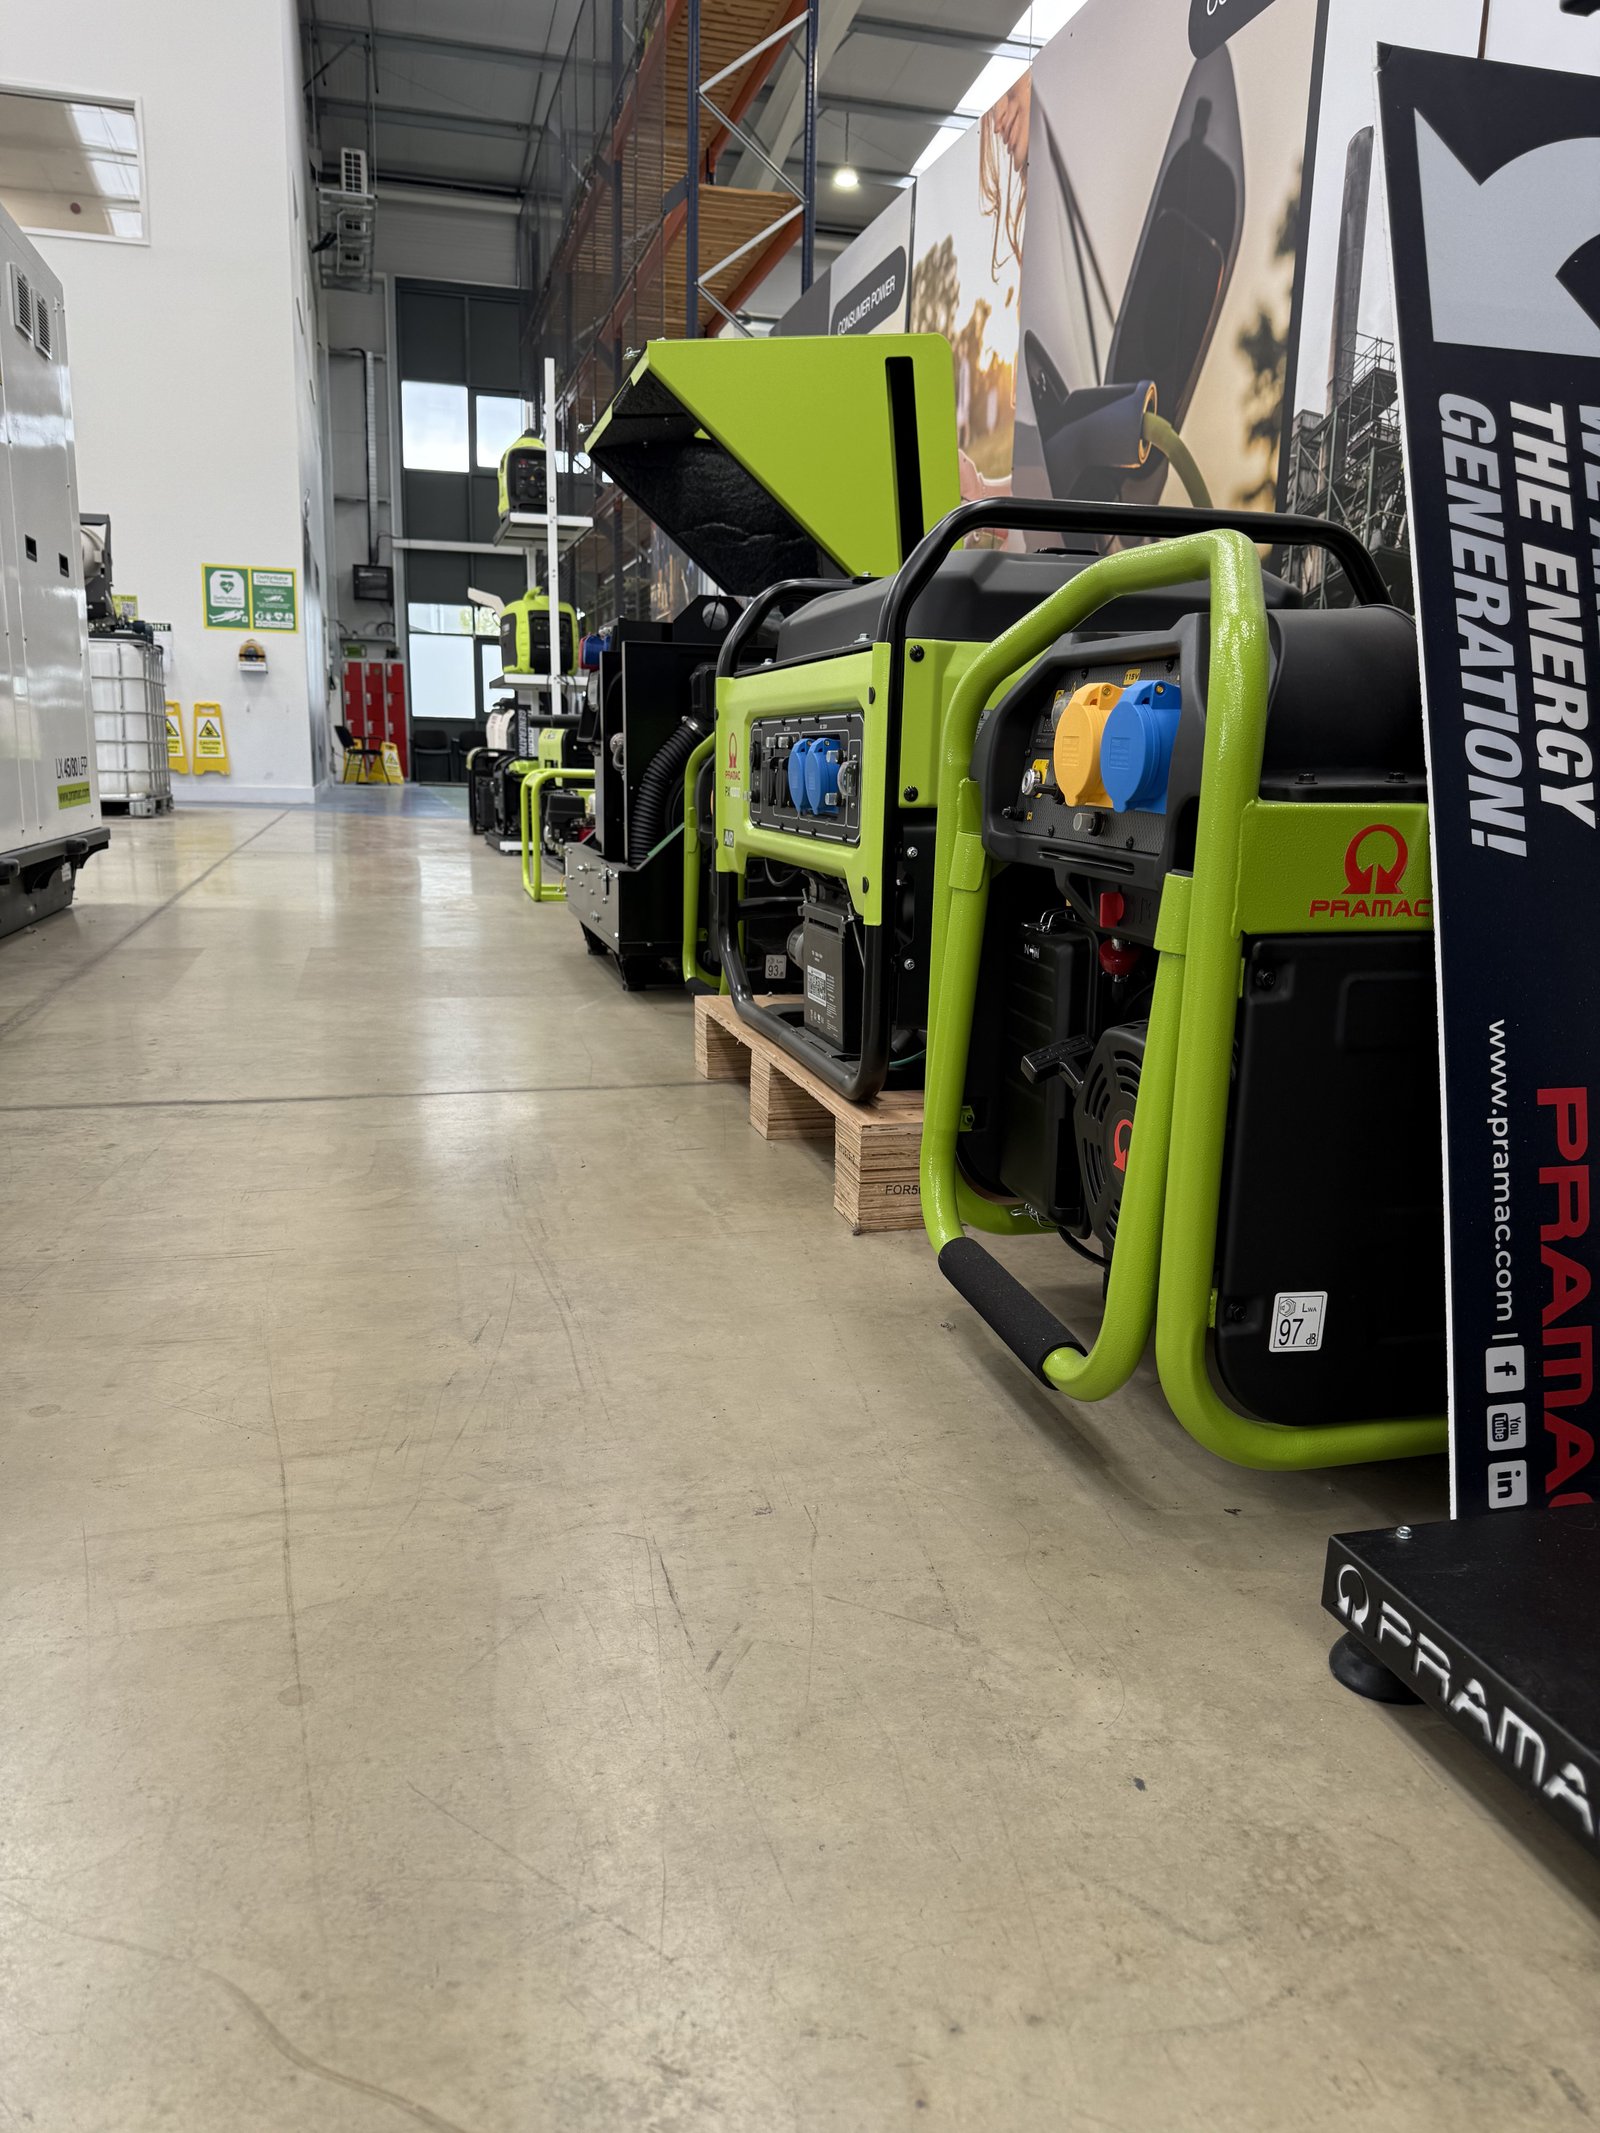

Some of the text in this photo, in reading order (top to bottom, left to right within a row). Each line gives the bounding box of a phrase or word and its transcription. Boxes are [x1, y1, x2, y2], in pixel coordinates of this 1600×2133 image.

[838, 275, 895, 335] CONSUMER POWER
[1439, 393, 1528, 858] GENERATION!
[1510, 401, 1596, 829] THE ENERGY
[1309, 899, 1431, 917] PRAMAC
[768, 965, 778, 977] 93
[1487, 1019, 1513, 1322] www.pramac.com
[1279, 1318, 1304, 1346] 97
[1306, 1333, 1316, 1345] dB
[1495, 1414, 1507, 1440] Tube
[1510, 1416, 1521, 1435] You
[1497, 1470, 1521, 1499] in
[1375, 1600, 1600, 1836] PRAMA
